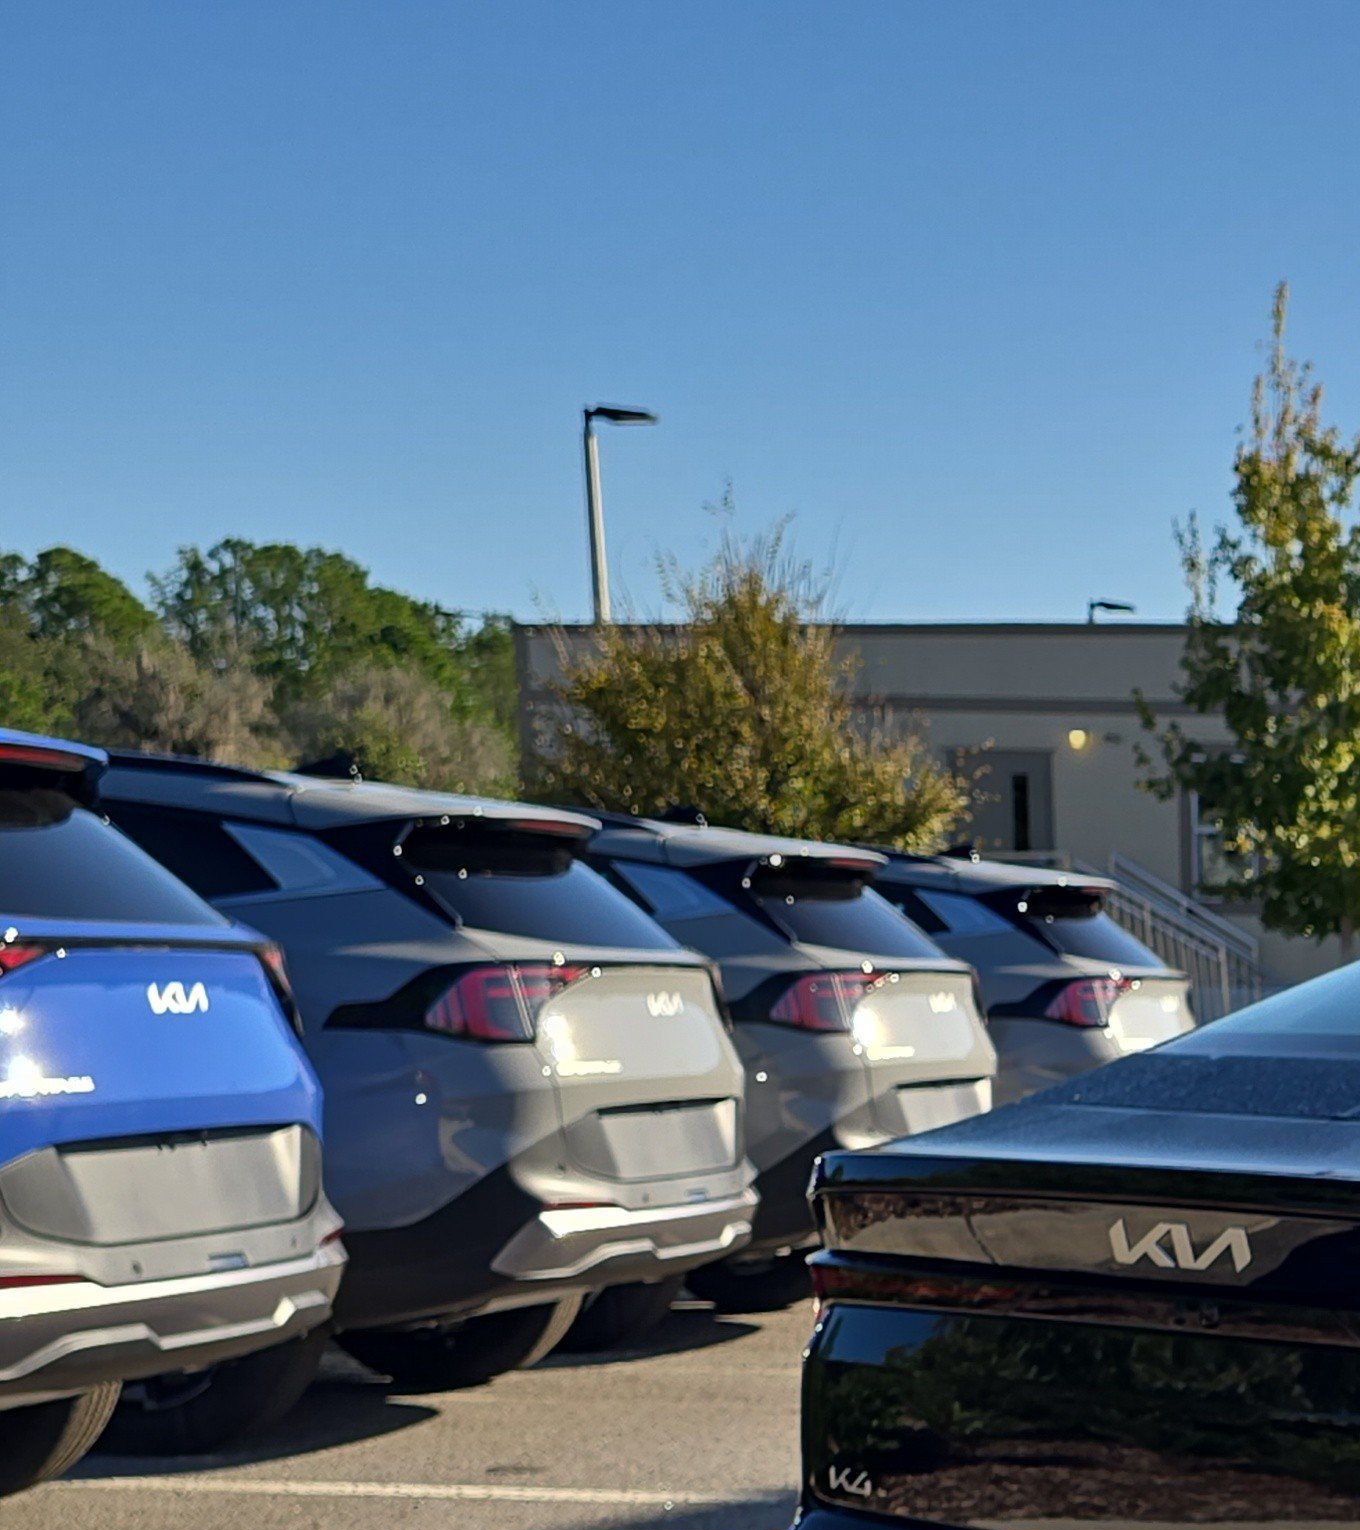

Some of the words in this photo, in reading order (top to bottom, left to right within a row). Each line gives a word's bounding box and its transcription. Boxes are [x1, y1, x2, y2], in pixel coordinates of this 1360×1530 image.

[146, 981, 210, 1015] KIA
[1109, 1217, 1252, 1274] KIA
[828, 1464, 873, 1497] K4
